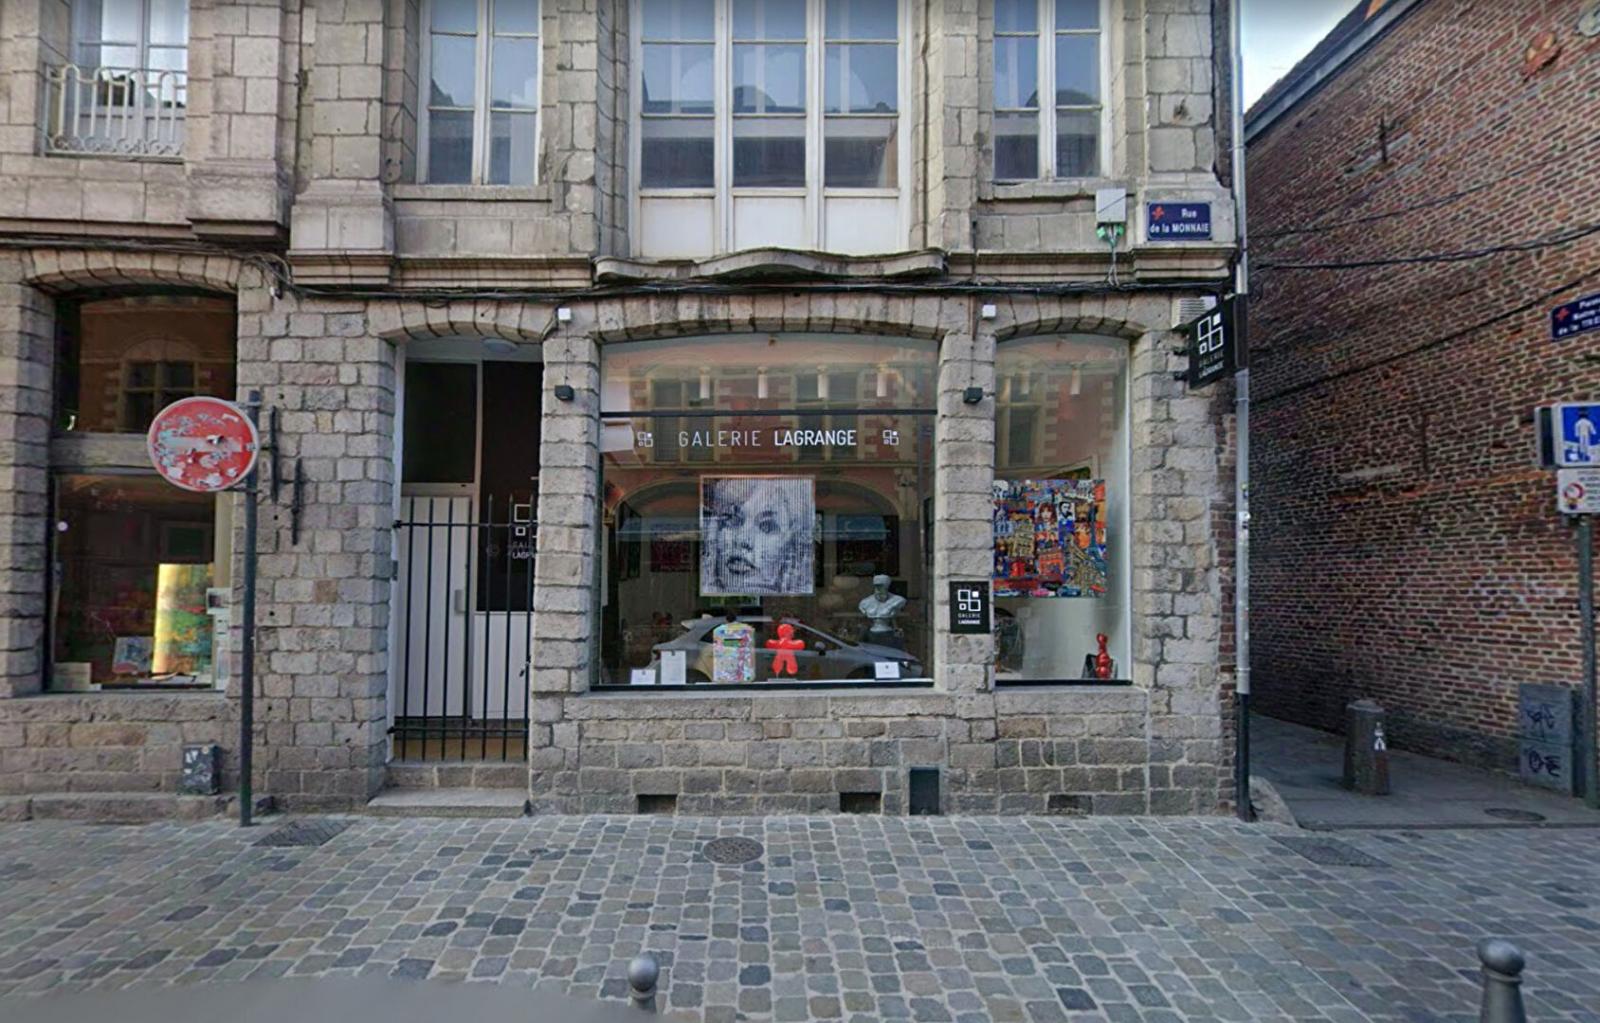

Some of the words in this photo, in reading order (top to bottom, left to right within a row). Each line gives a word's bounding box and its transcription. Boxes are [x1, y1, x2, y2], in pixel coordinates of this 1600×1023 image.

[1181, 208, 1197, 219] Rue
[1150, 223, 1160, 233] de
[1161, 223, 1170, 233] la
[1171, 223, 1209, 233] MONNAIE
[678, 430, 761, 447] GALERIE
[774, 429, 857, 446] LAGRANGE
